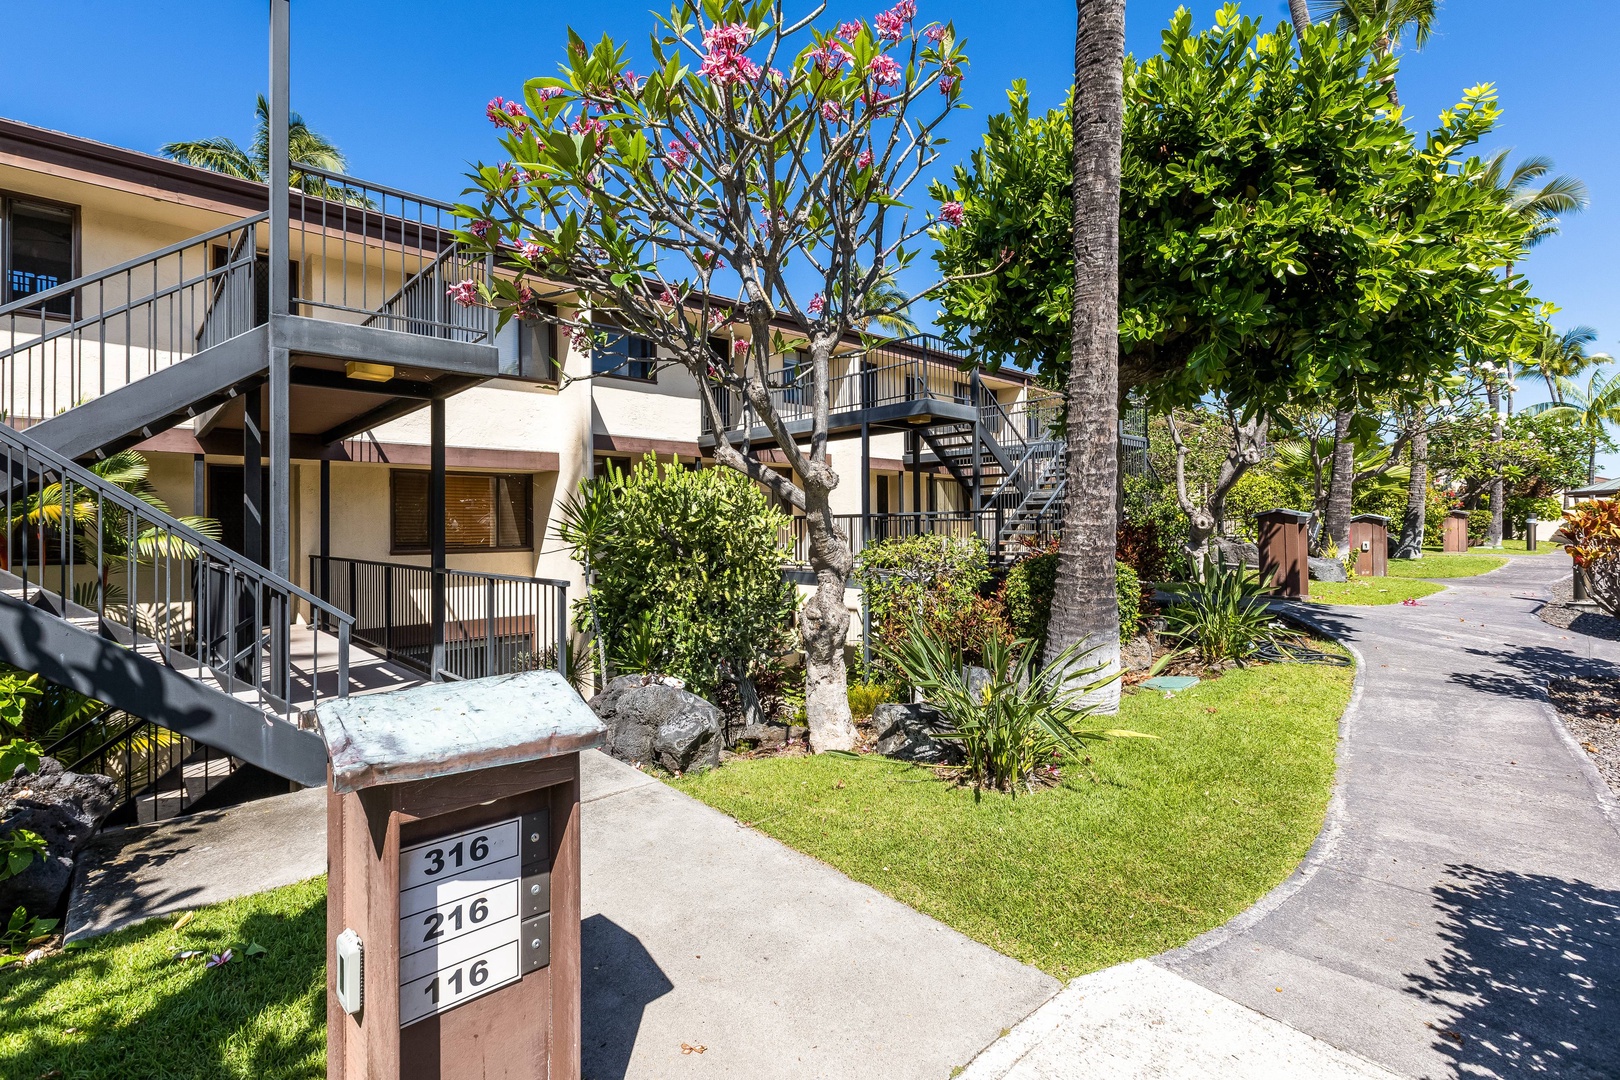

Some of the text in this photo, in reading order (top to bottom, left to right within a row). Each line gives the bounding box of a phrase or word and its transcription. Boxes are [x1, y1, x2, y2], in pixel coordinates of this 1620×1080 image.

[423, 835, 489, 876] 316
[423, 897, 489, 943] 216
[424, 959, 489, 1005] 116
